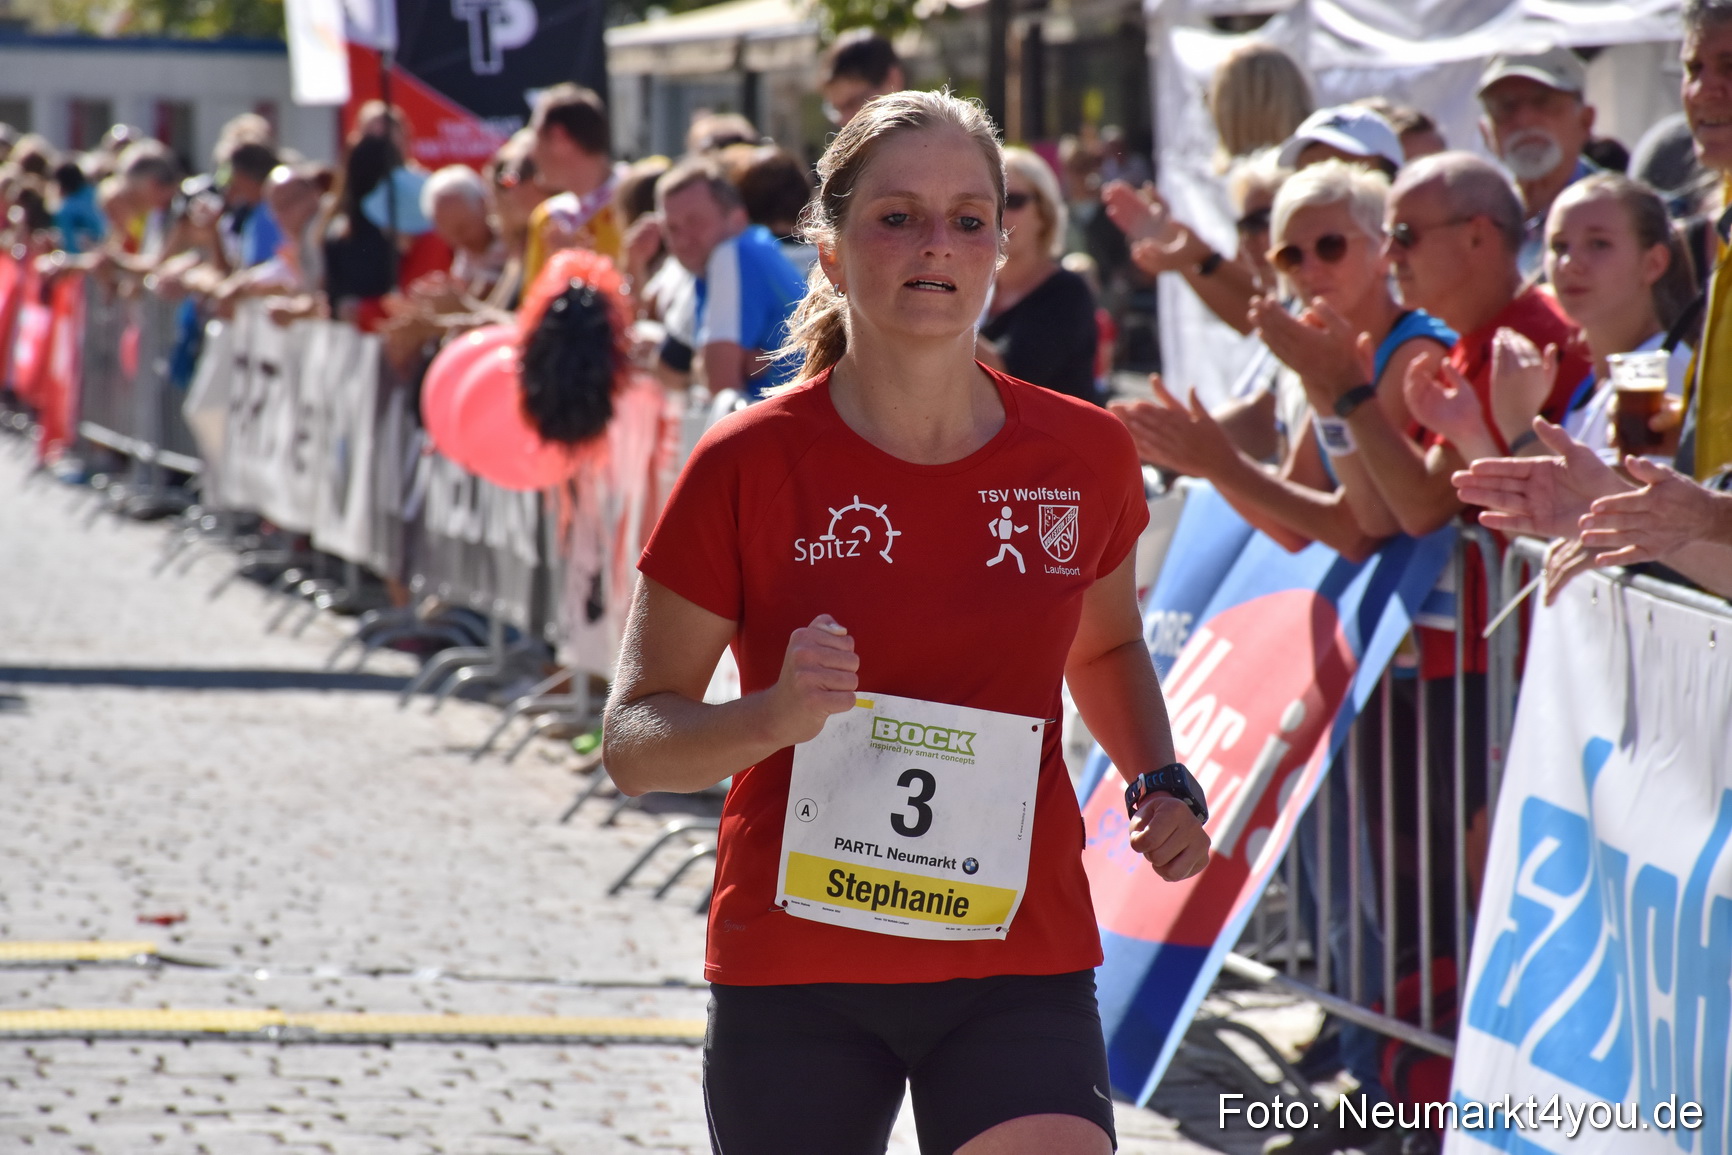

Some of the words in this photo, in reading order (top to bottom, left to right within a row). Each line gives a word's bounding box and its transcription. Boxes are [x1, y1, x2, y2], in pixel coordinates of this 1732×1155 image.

[978, 489, 1009, 503] TSV
[1013, 487, 1081, 502] Wolfstein
[794, 537, 861, 565] Spitz
[1054, 520, 1075, 558] TSV
[1044, 564, 1080, 577] Laufsport
[872, 716, 977, 756] BOCK
[870, 742, 902, 753] inspired
[903, 748, 914, 757] by
[915, 750, 939, 760] smart
[940, 753, 975, 765] concepts
[801, 804, 811, 817] A
[890, 768, 937, 838] 3
[834, 837, 883, 858] PARTL
[887, 847, 957, 870] Neumarkt
[827, 869, 969, 917] Stephanie
